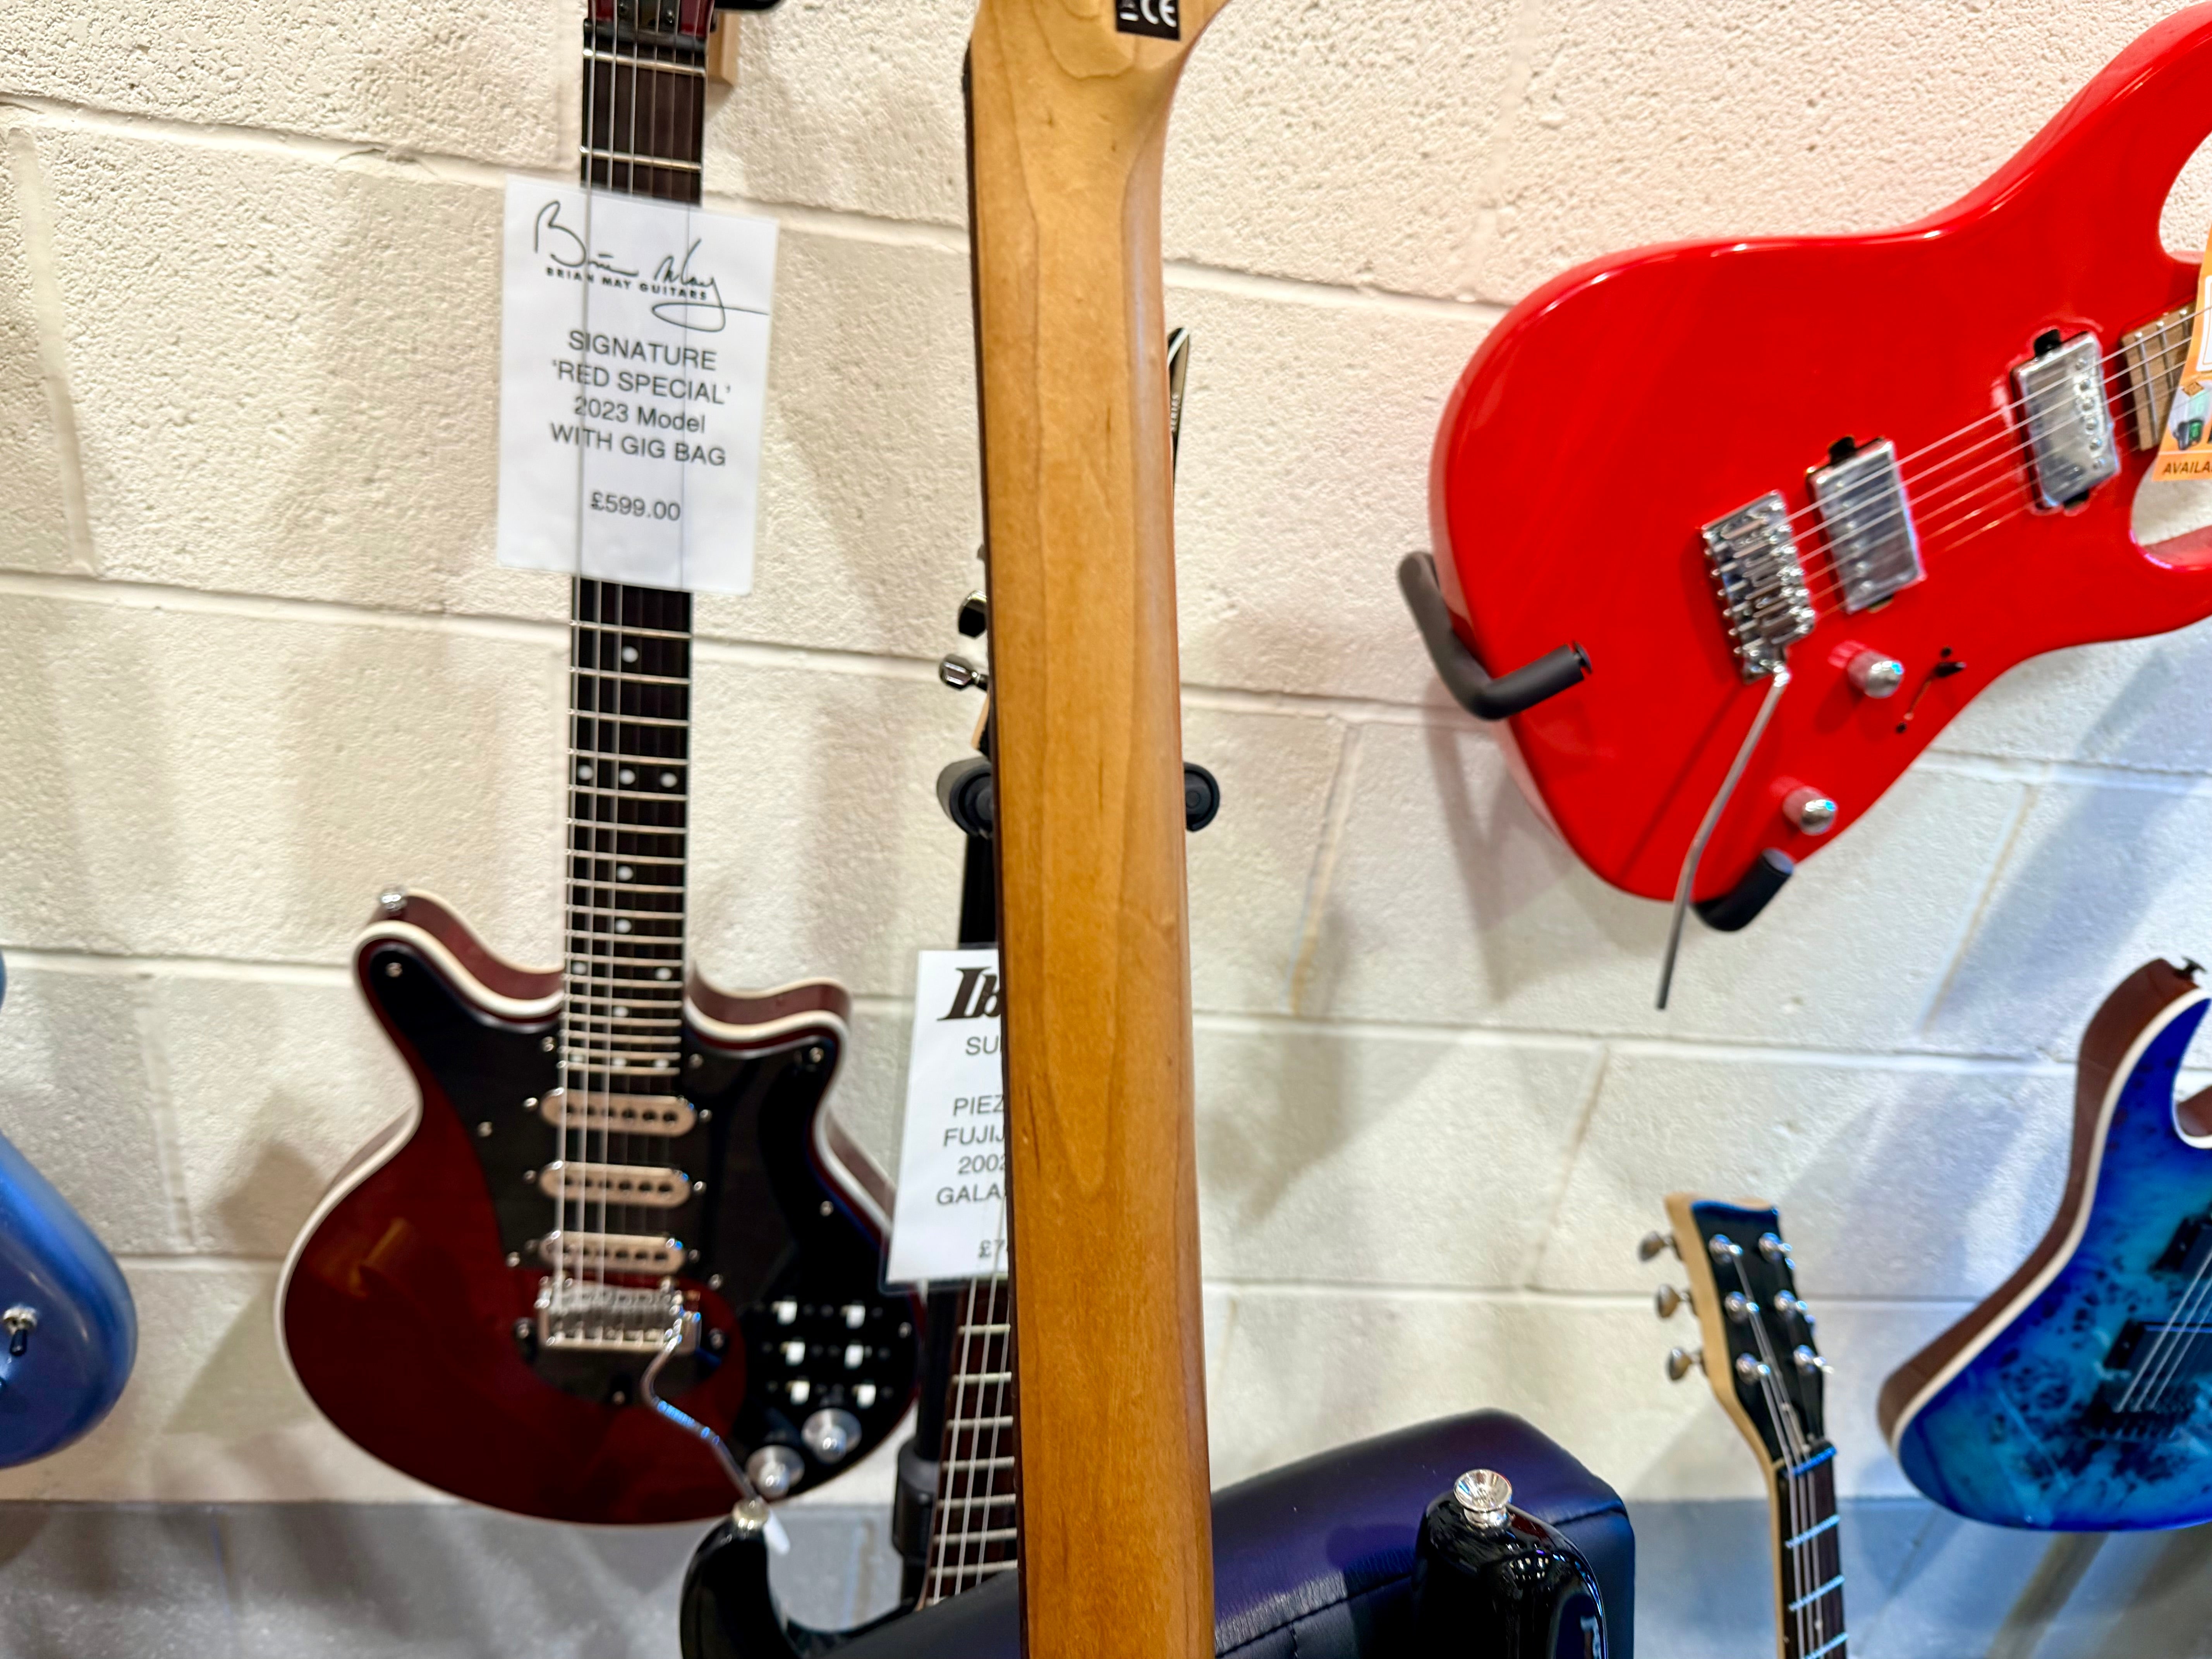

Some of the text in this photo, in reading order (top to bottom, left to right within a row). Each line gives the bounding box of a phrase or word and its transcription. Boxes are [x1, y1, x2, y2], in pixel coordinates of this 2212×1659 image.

[546, 266, 707, 301] BRIAN MAY GUITARS
[568, 330, 717, 371] SIGNATURE
[574, 396, 705, 434] 2023 Model
[550, 422, 726, 467] WITH GIG BAG
[591, 491, 681, 522] £599.00
